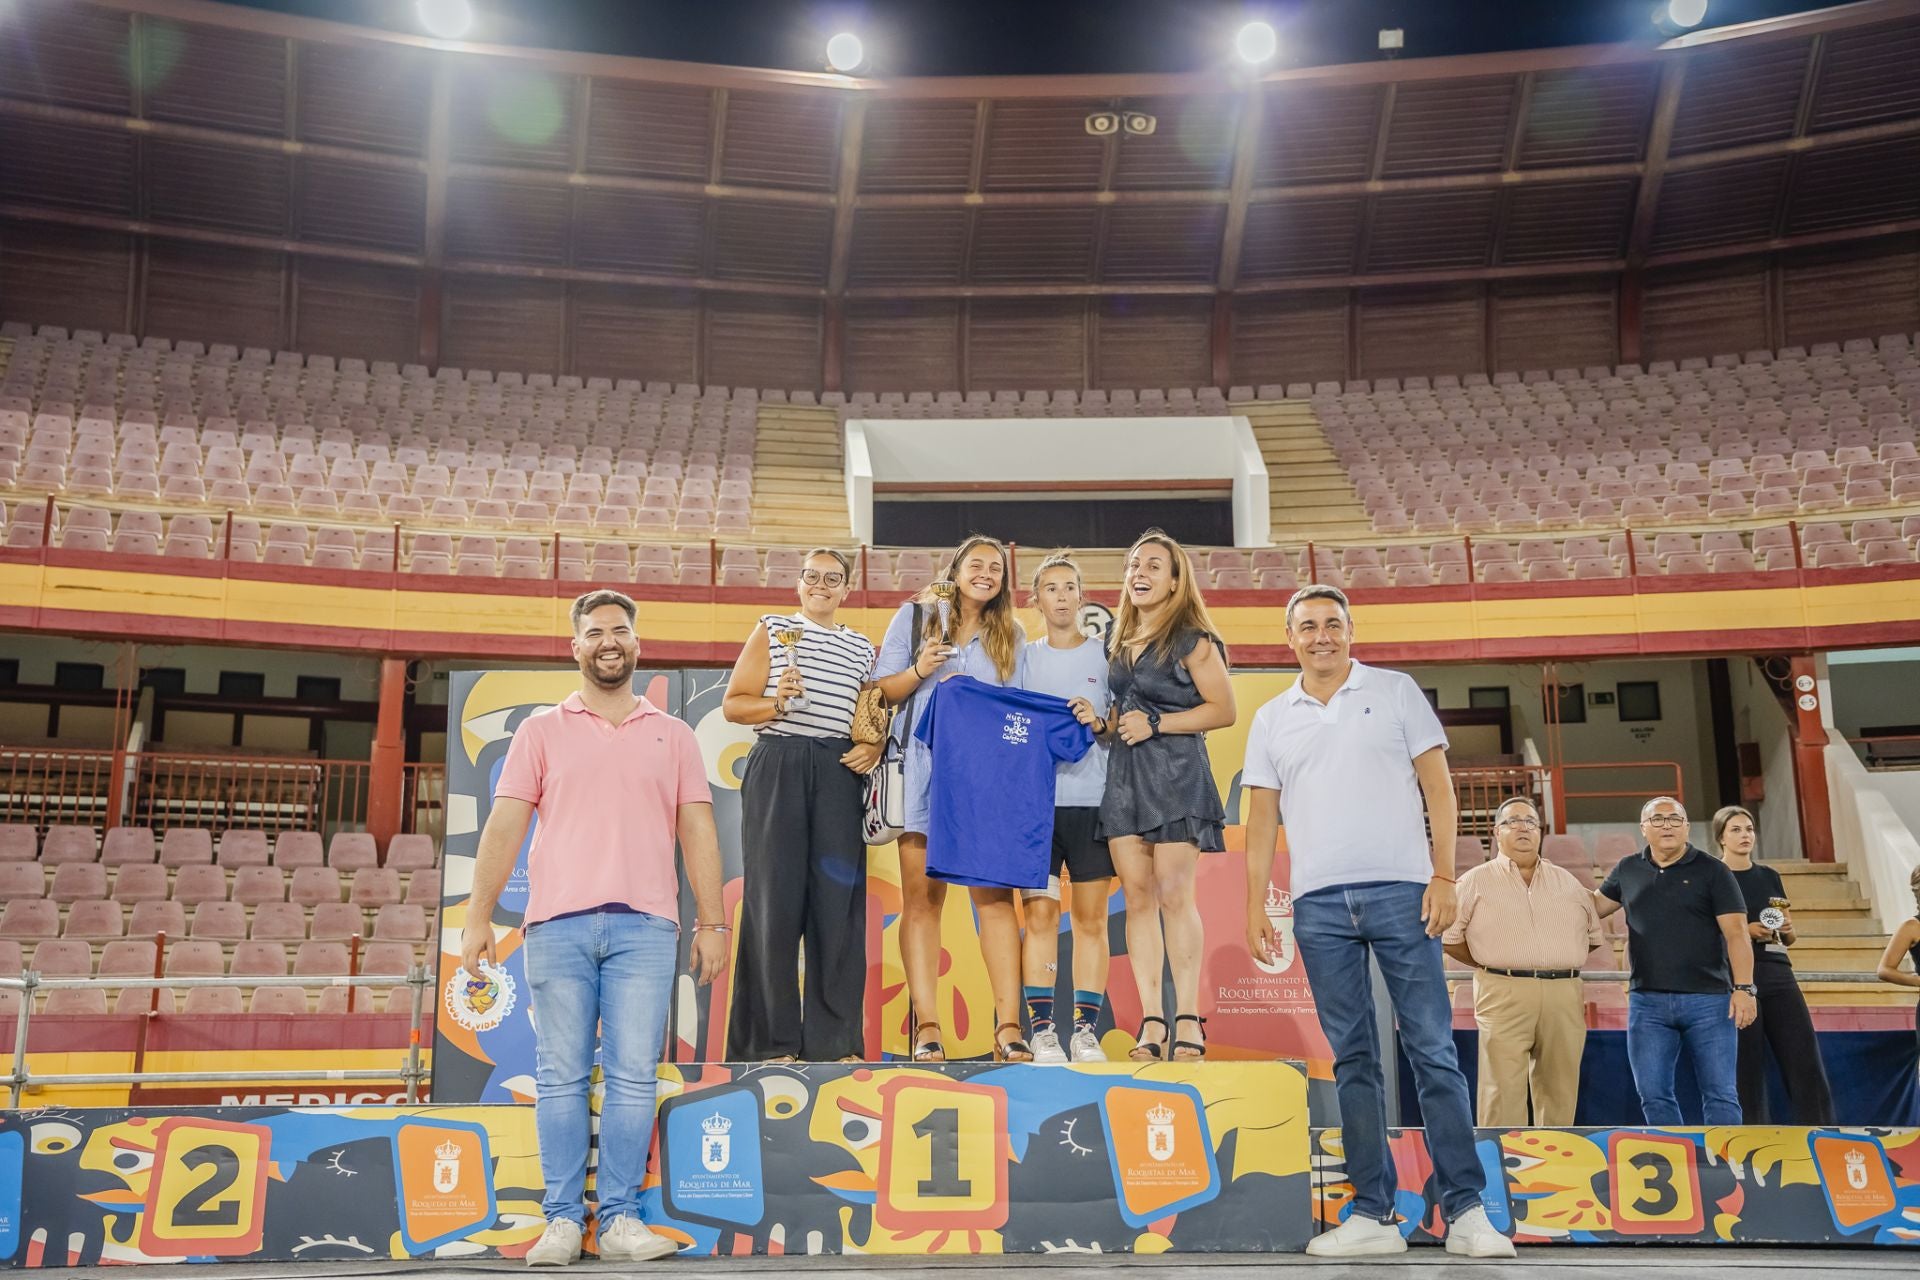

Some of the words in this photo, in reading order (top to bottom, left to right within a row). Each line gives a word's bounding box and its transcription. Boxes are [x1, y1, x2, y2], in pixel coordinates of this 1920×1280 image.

[1084, 612, 1101, 635] 5
[1238, 977, 1300, 985] AYUNTAMIENTO
[1219, 987, 1280, 1001] ROQUETAS
[1283, 988, 1297, 999] DE
[1303, 986, 1313, 998] M
[1297, 1007, 1316, 1015] Tiemp
[475, 1020, 497, 1030] VIDA
[912, 1108, 971, 1197] 1
[171, 1144, 240, 1226] 2
[1628, 1152, 1679, 1216] 3
